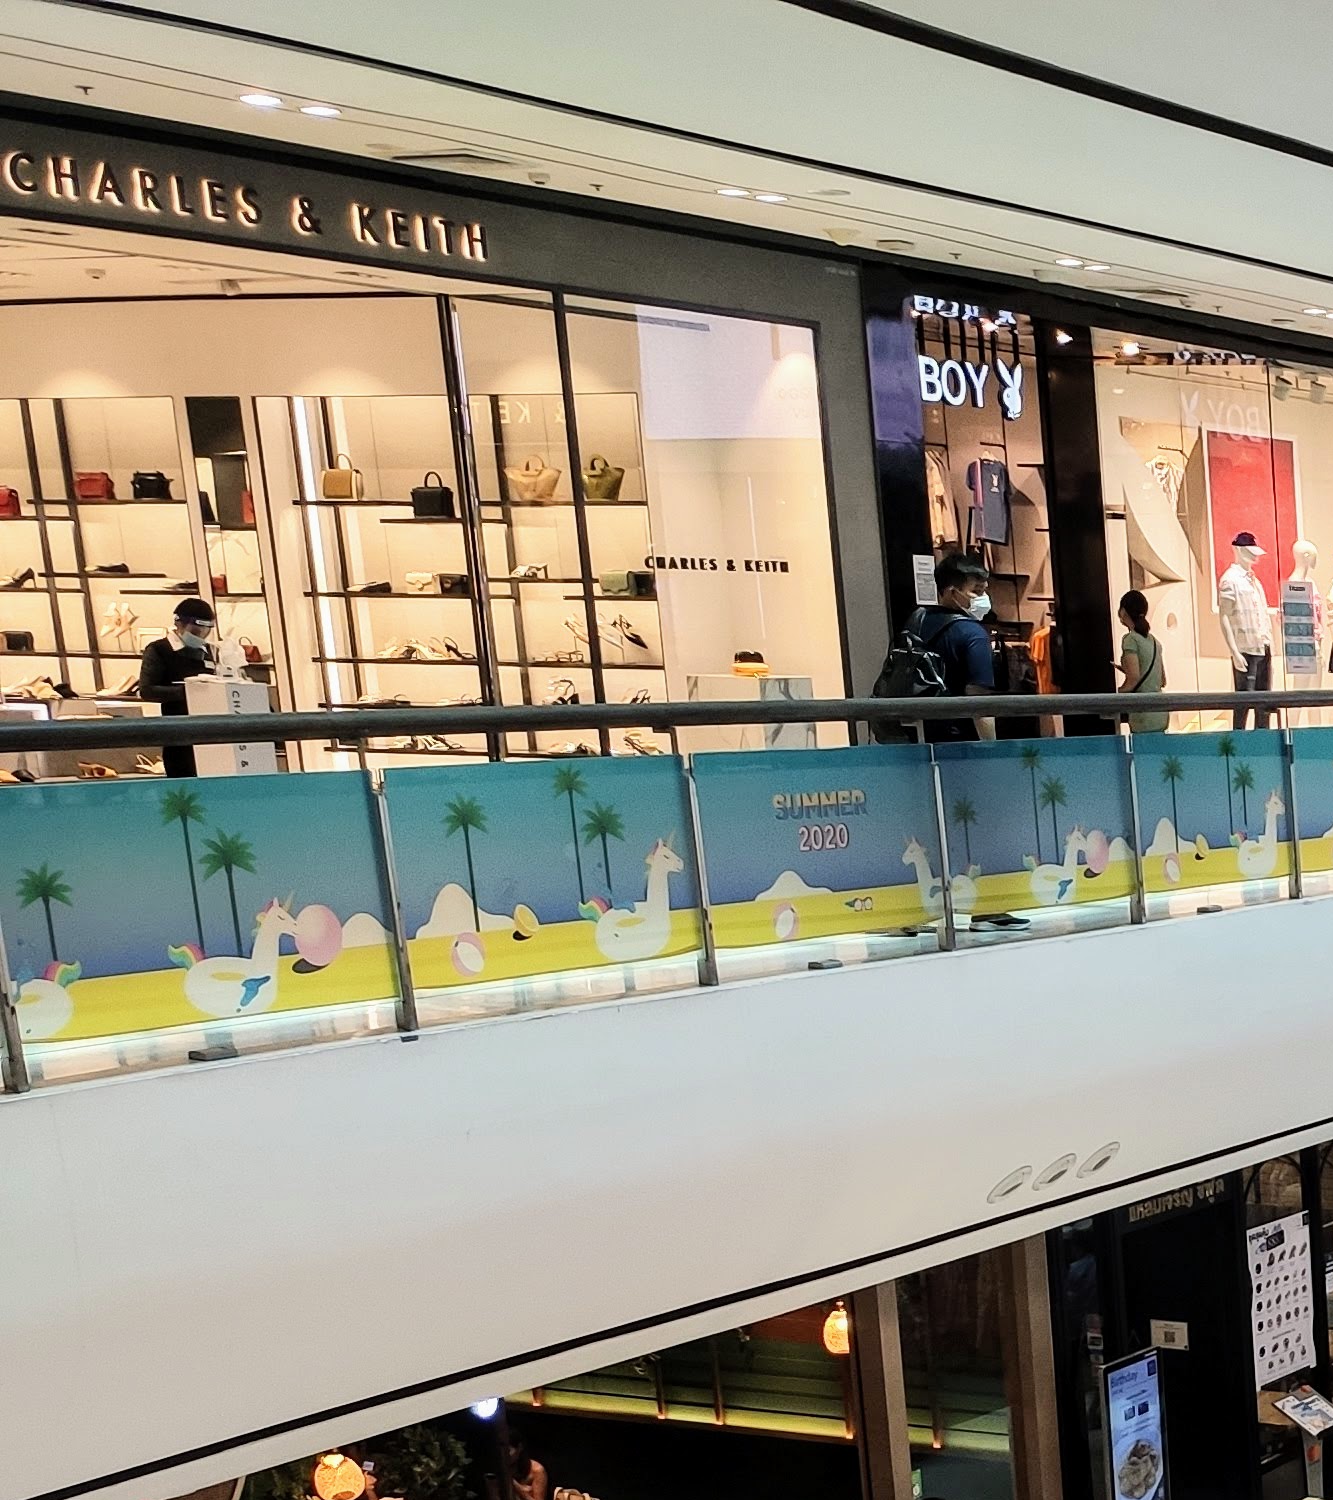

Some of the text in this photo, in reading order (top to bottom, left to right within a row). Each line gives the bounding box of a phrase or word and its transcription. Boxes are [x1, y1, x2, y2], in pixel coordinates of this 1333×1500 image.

[2, 151, 490, 263] CHARLES & KEITH
[918, 354, 990, 410] BOY
[645, 556, 789, 573] CHARLES & KEITH
[772, 789, 868, 820] SUMMER
[798, 822, 850, 851] 2020
